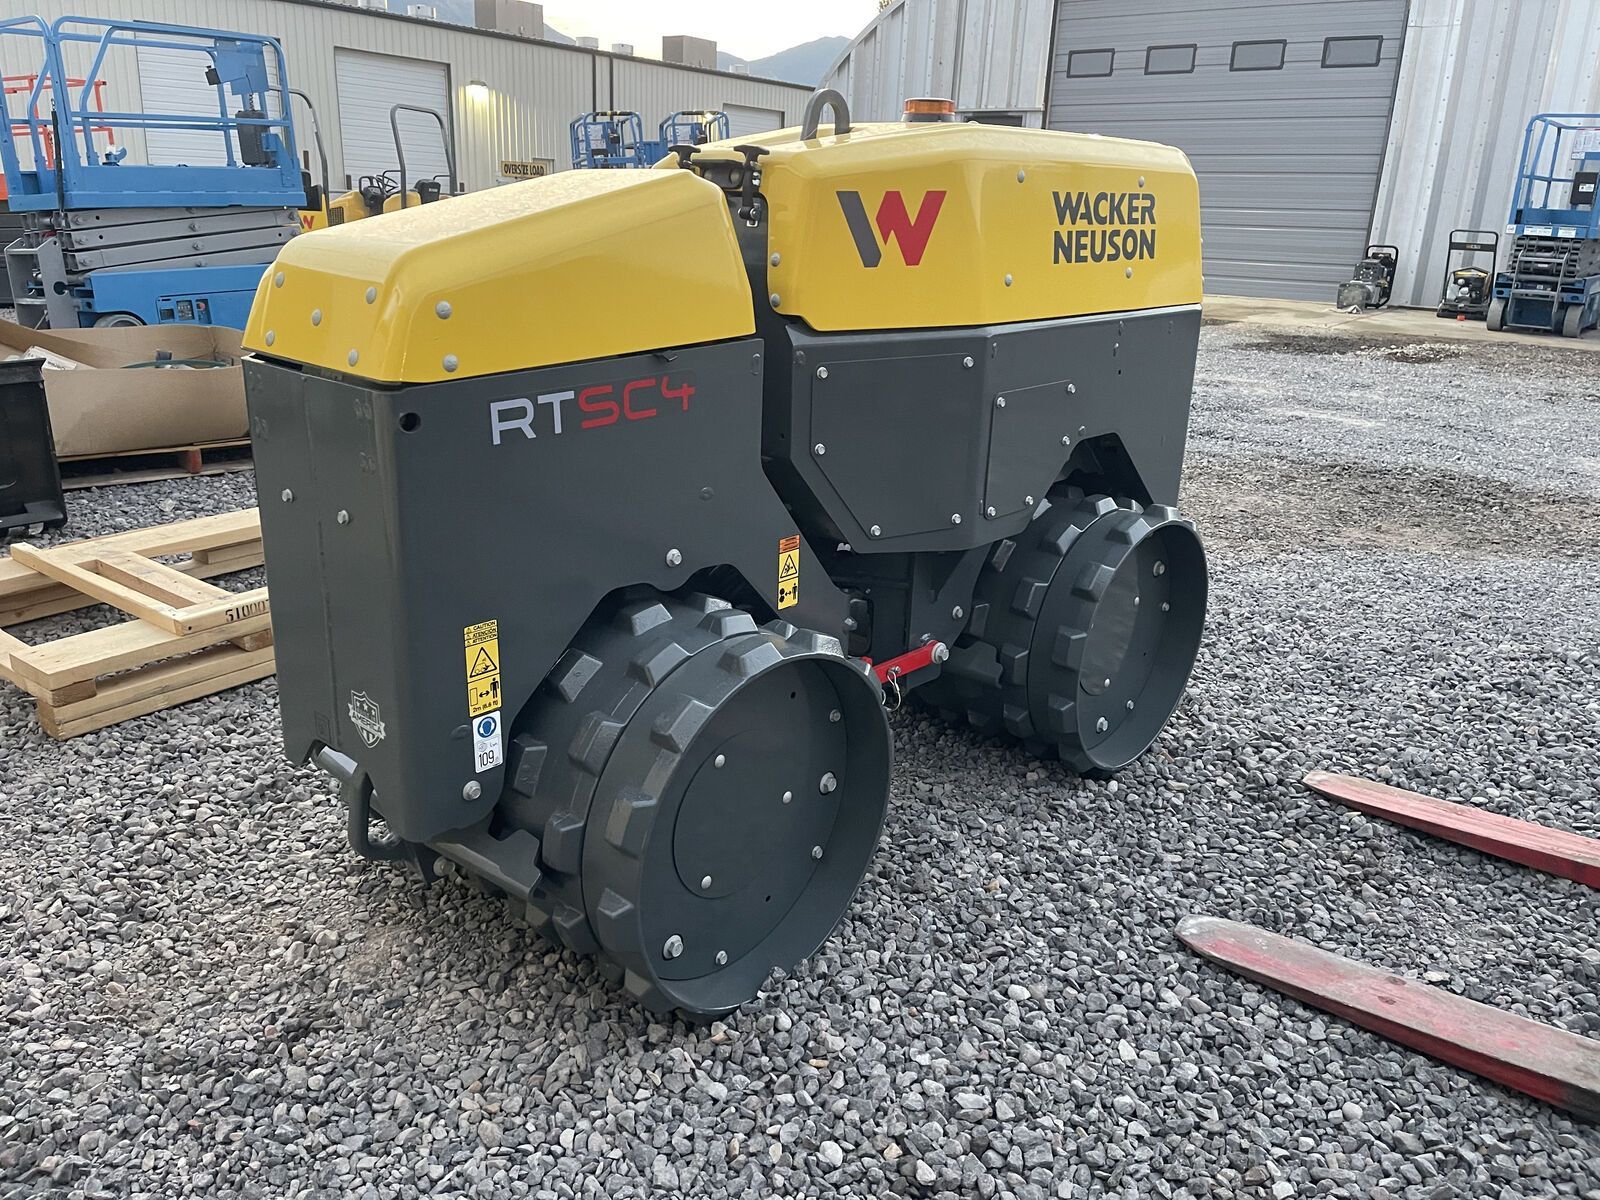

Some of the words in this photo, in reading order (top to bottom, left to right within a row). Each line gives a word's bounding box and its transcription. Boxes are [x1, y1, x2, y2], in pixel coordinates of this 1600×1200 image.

[503, 163, 529, 176] OVERSZE
[530, 164, 545, 177] LOAD
[1052, 191, 1156, 226] WACKER
[1053, 228, 1156, 265] NEUSON
[473, 620, 496, 631] CAUTION
[472, 705, 482, 713] 2m
[478, 749, 495, 768] 109
